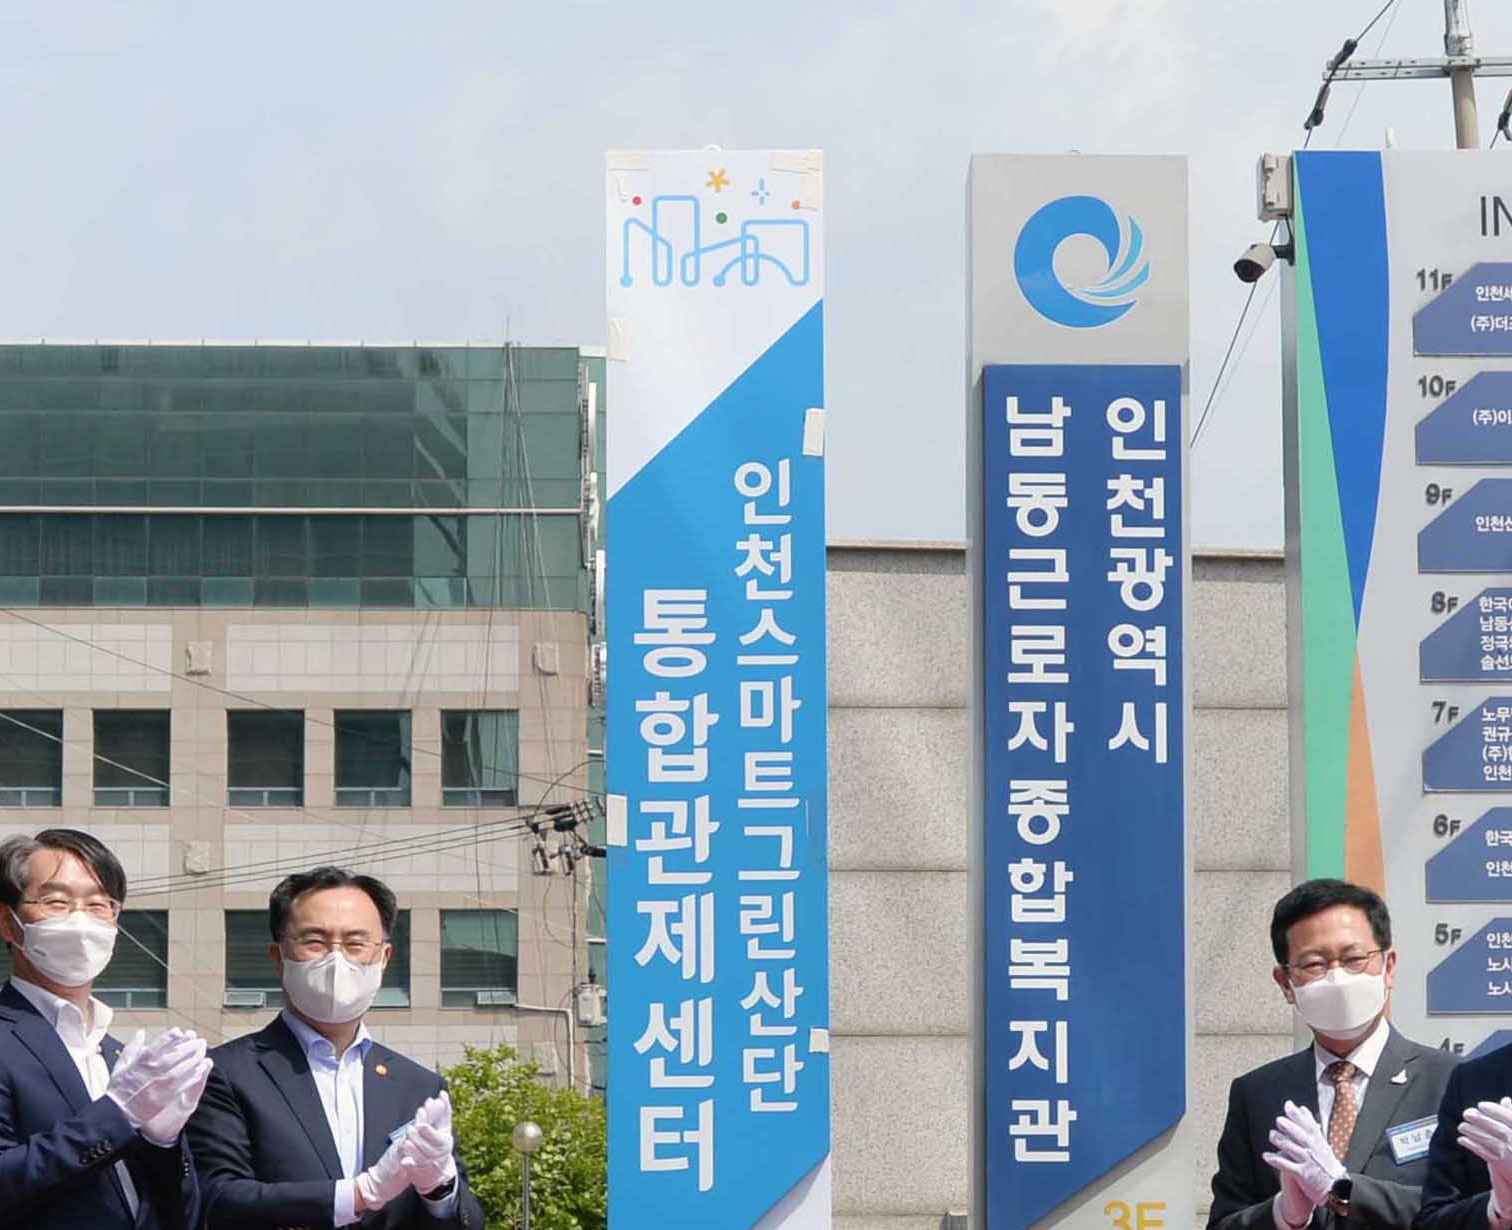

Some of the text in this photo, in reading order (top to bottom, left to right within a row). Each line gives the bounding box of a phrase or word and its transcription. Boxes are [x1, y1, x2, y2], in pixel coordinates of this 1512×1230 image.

[1416, 268, 1452, 291] 11F
[1418, 375, 1456, 397] 10F
[1425, 483, 1453, 505] 9F
[1105, 396, 1172, 765] 인천광역시
[1431, 701, 1460, 723] 7F
[733, 458, 804, 1114] 인천스마트그린산단
[1005, 395, 1077, 1165] 남동근로자종합복지관
[1433, 814, 1461, 838] 6F
[632, 586, 717, 1193] 통합관제센터
[1435, 924, 1463, 946] 5F
